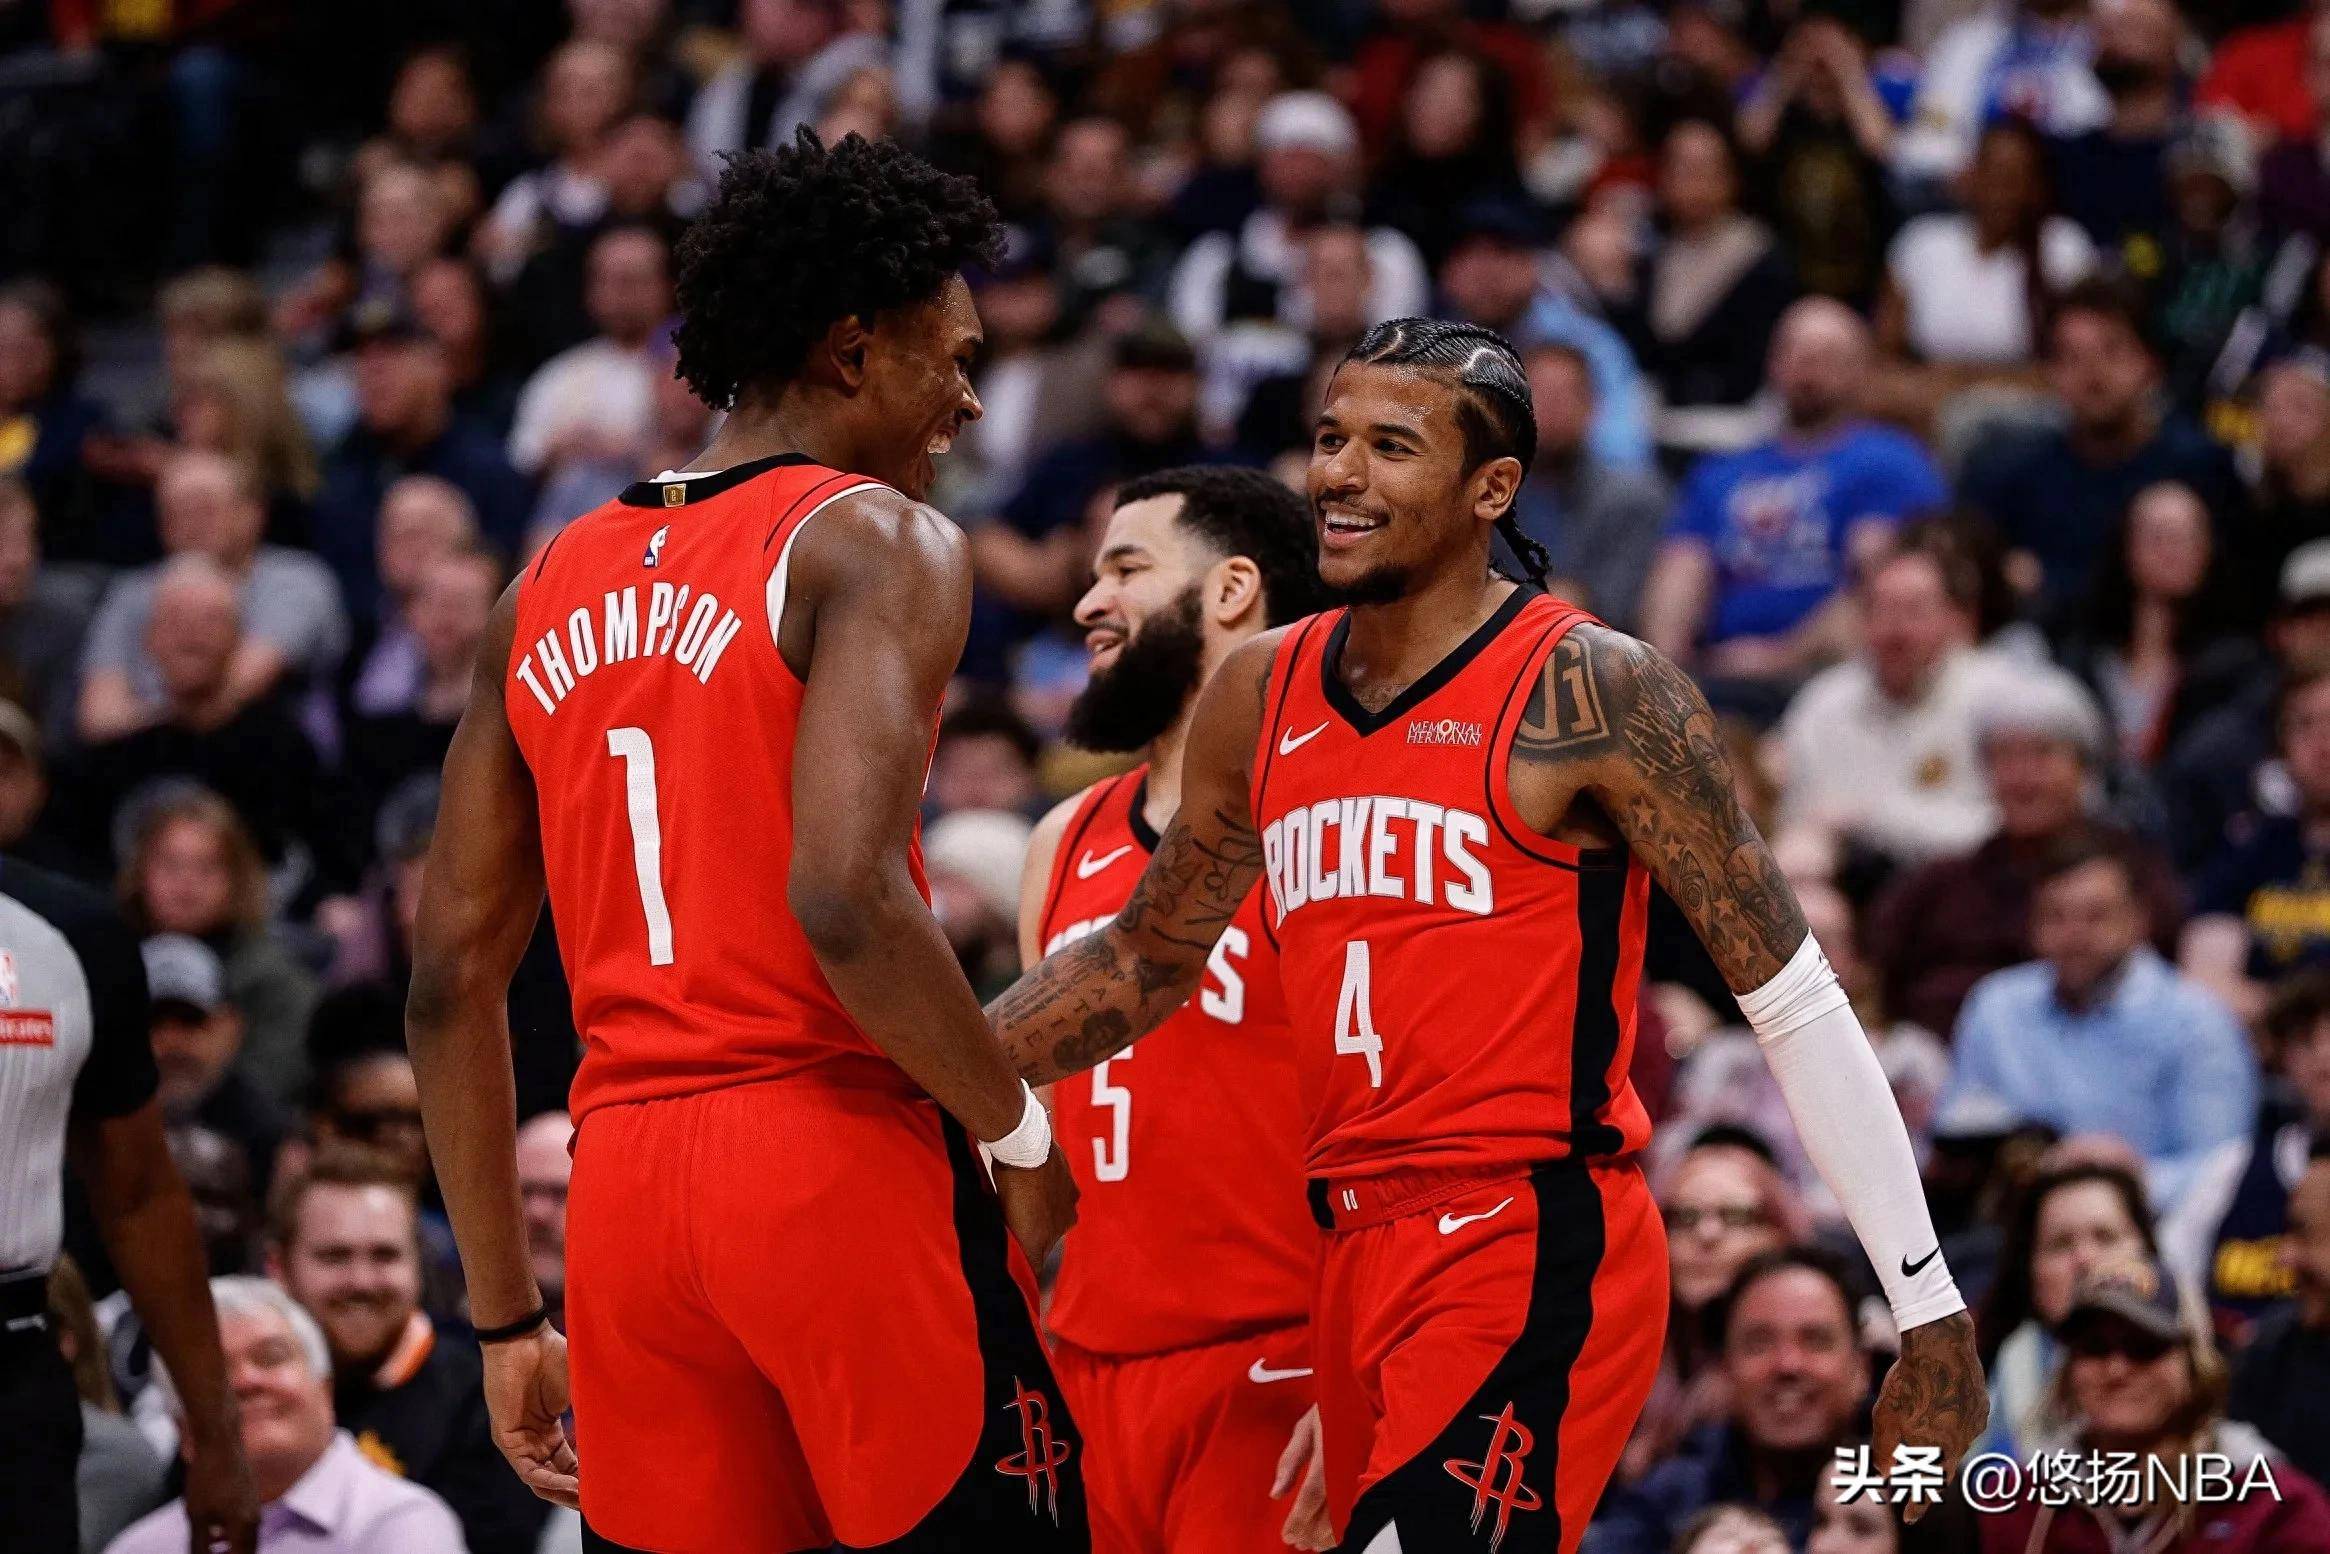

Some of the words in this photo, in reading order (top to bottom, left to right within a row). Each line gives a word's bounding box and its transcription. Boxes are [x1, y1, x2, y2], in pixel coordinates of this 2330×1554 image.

[515, 581, 743, 717] THOMPSON
[1406, 730, 1482, 746] HERMANN
[1408, 719, 1482, 736] MEMORIAL
[606, 726, 674, 967] 1
[1262, 795, 1494, 930] ROCKETS
[1334, 940, 1384, 1088] 4
[1091, 1044, 1131, 1182] 5
